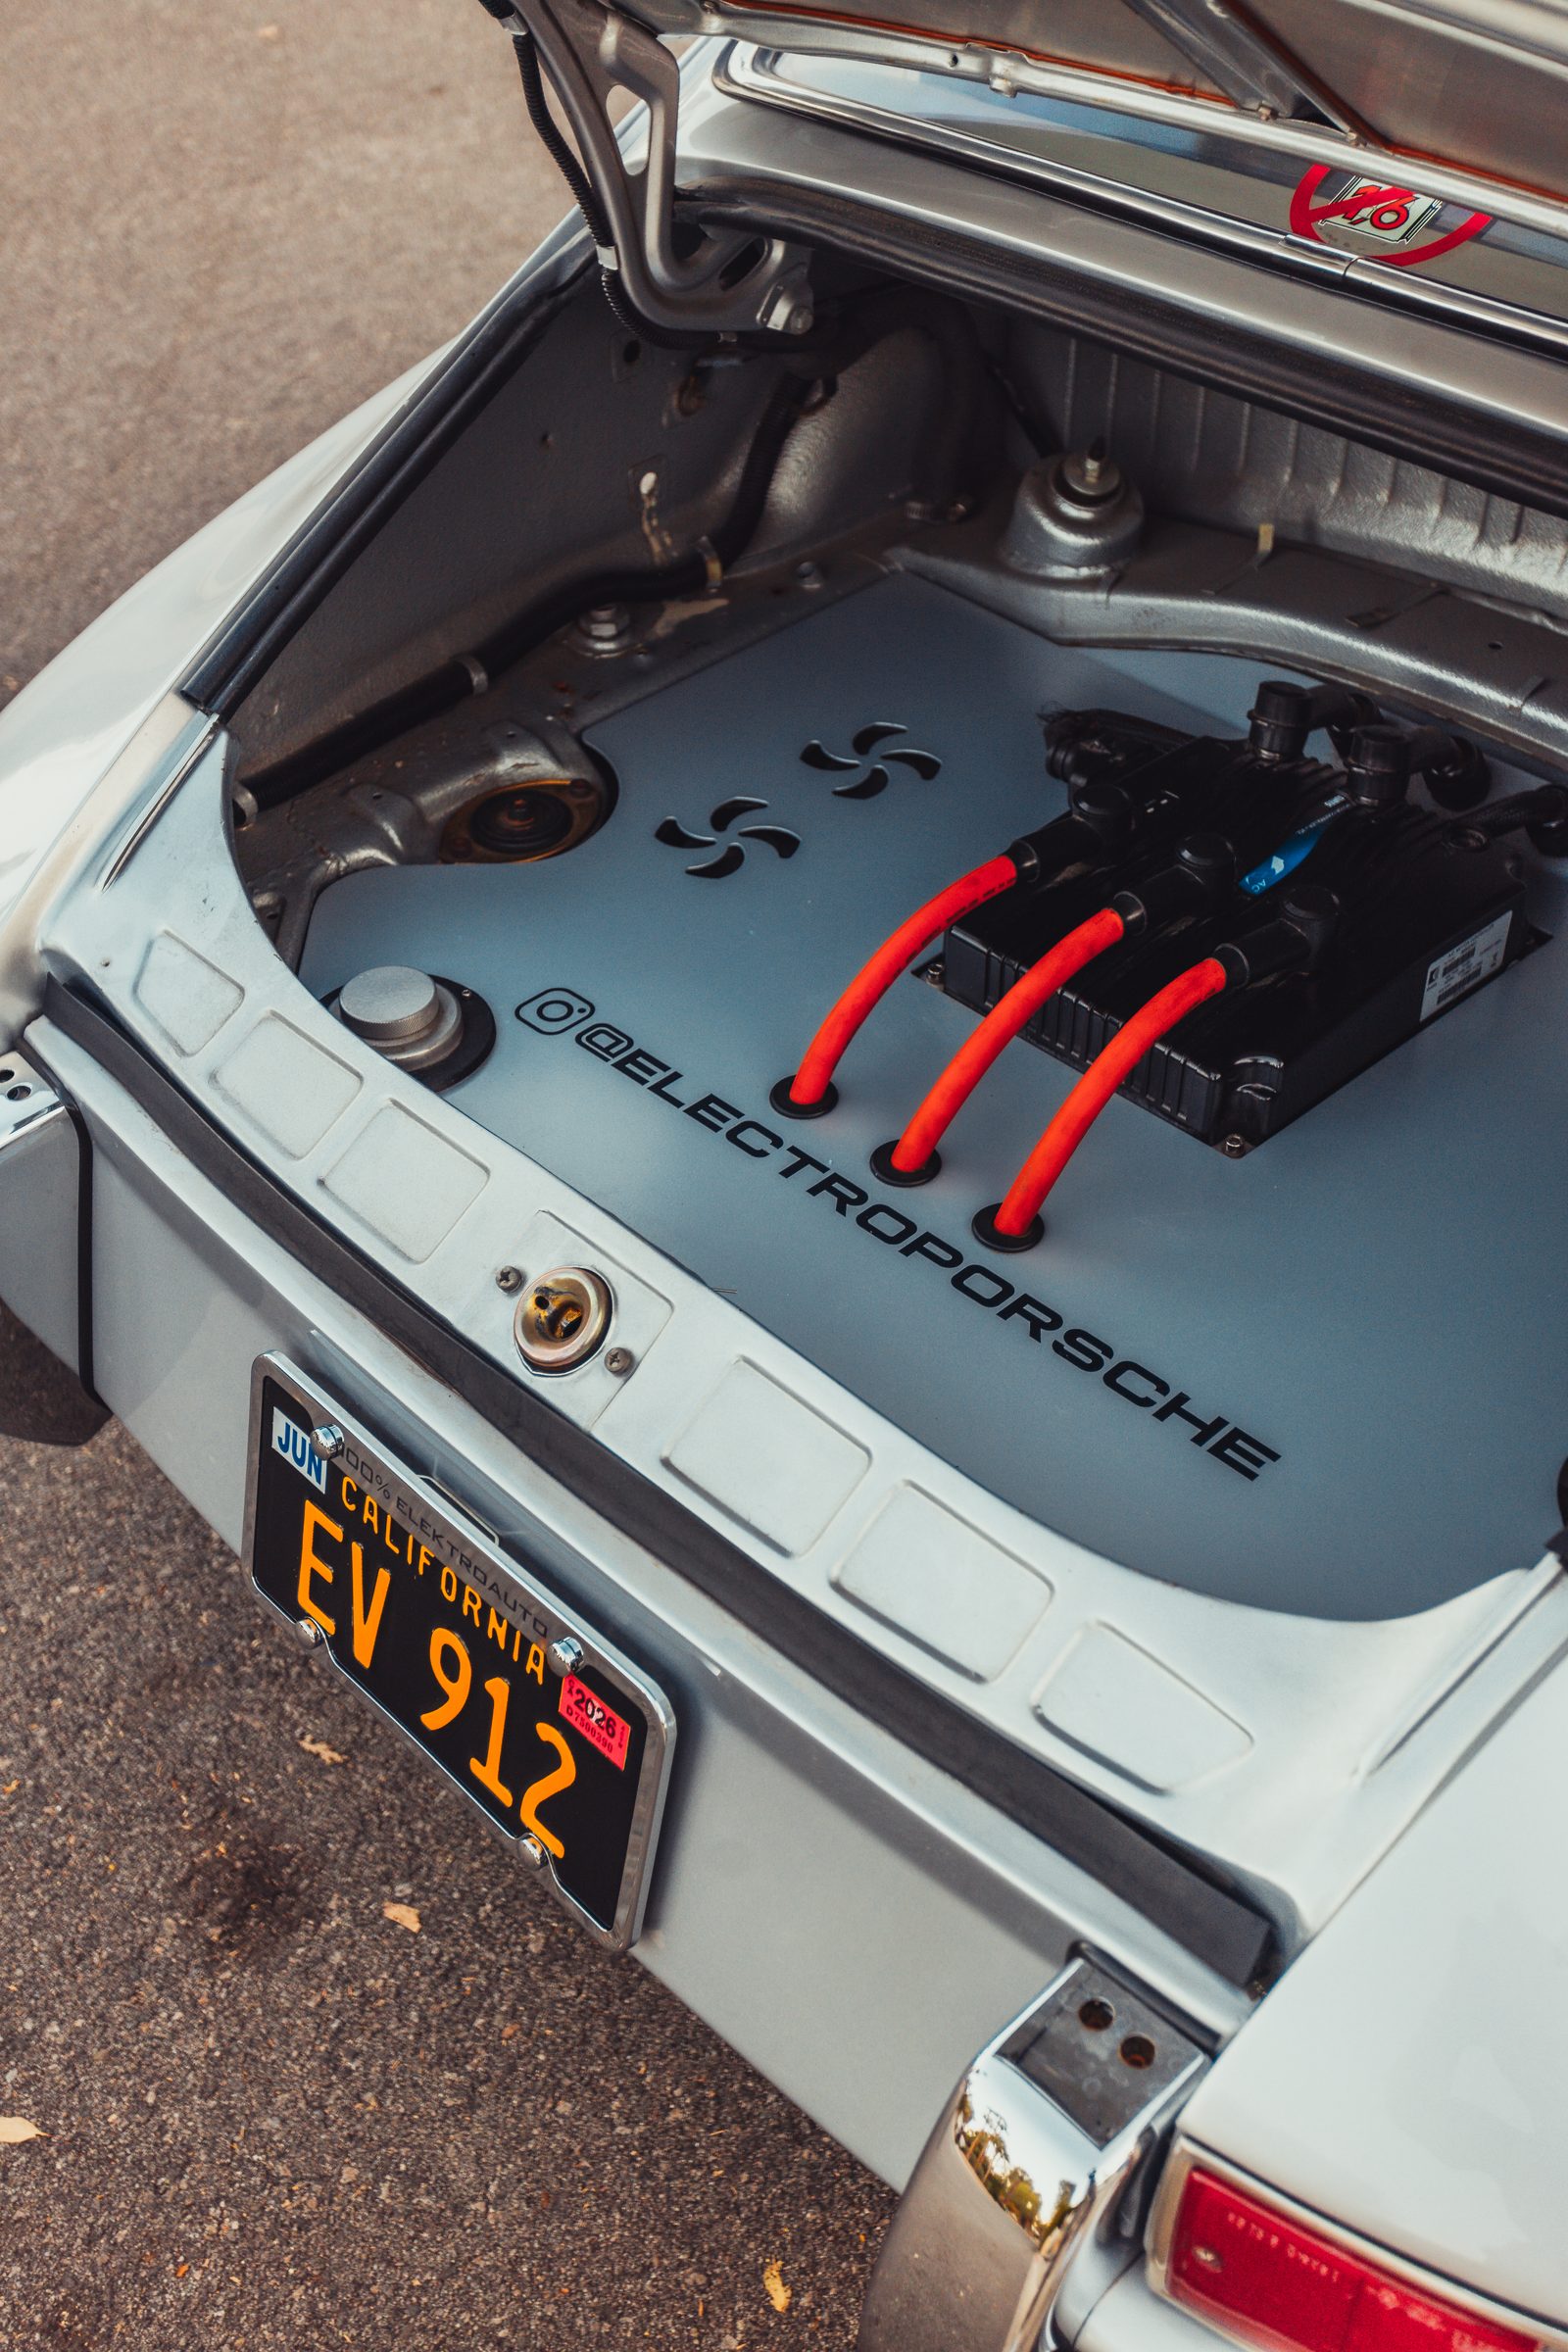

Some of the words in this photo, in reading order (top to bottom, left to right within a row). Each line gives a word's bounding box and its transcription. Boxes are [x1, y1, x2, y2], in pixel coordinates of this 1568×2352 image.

[574, 1022, 1281, 1482] @ELECTROPORSCHE
[277, 1422, 323, 1486] JUN
[341, 1475, 547, 1686] CALIFORNIA
[396, 1495, 550, 1639] ELEKTROAUTO
[297, 1498, 391, 1671] EV
[419, 1625, 577, 1860] 912
[573, 1688, 616, 1740] 2026
